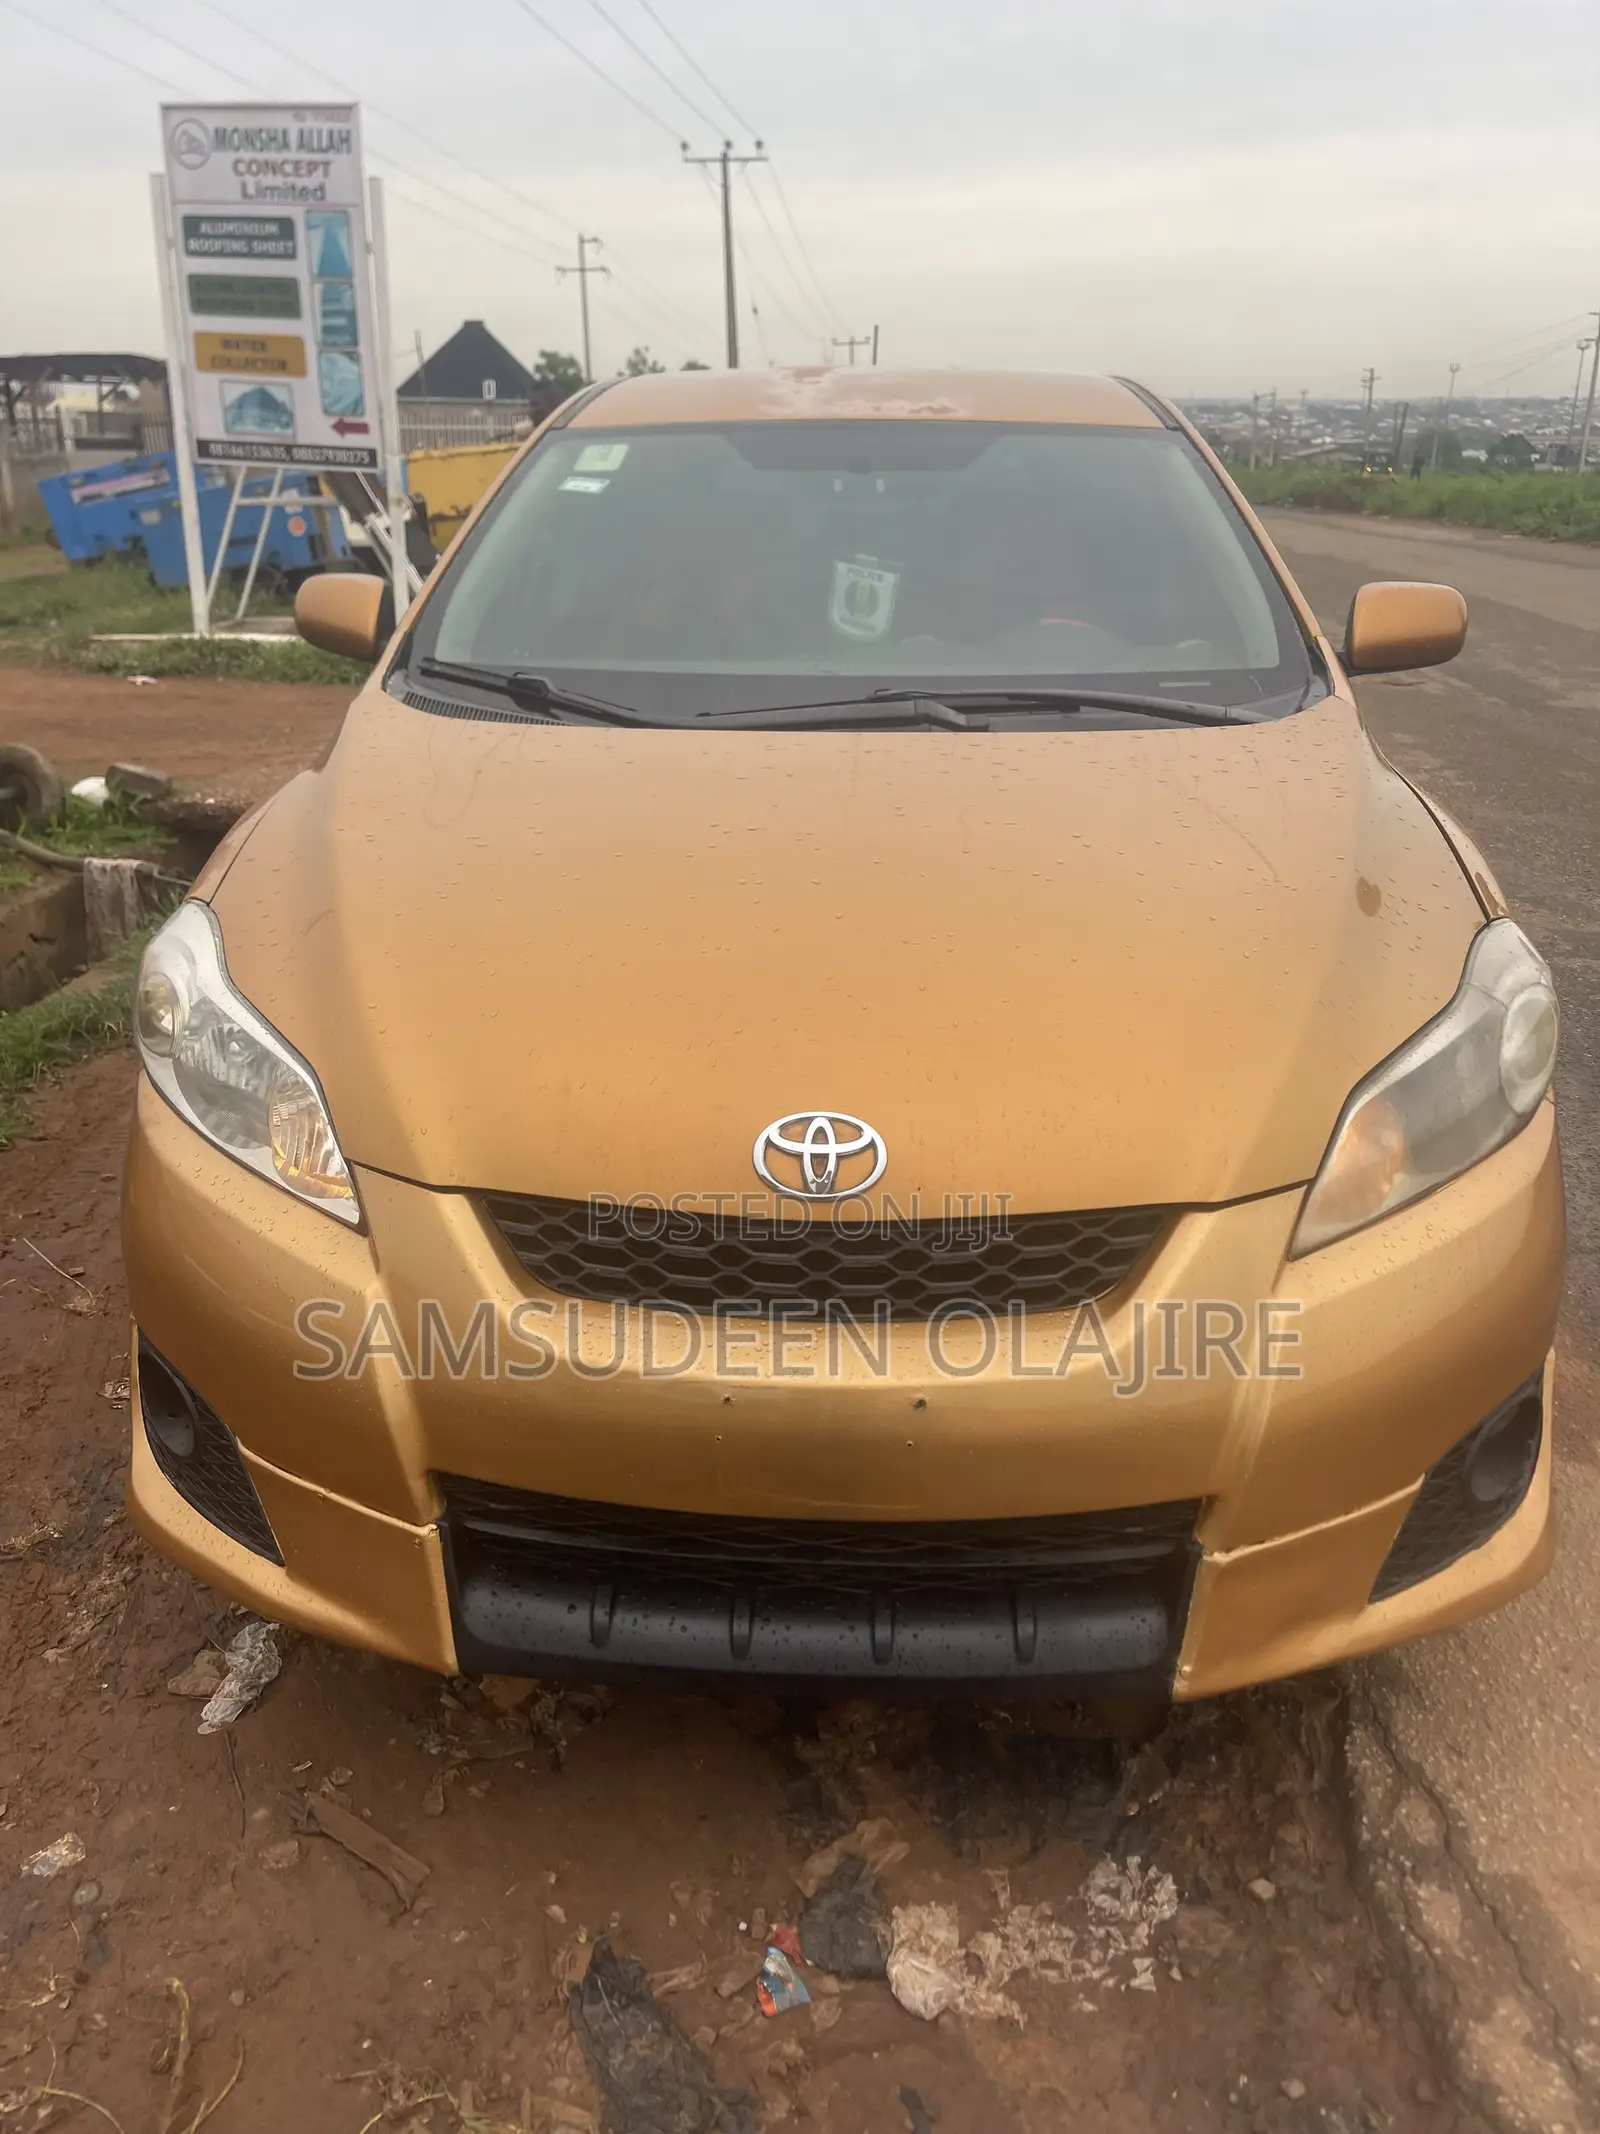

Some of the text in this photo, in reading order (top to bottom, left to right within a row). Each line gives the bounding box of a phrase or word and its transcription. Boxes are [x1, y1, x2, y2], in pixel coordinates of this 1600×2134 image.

[213, 126, 353, 154] MONSHA ALLAH
[232, 158, 333, 178] CONCEPT
[240, 181, 326, 201] Limited
